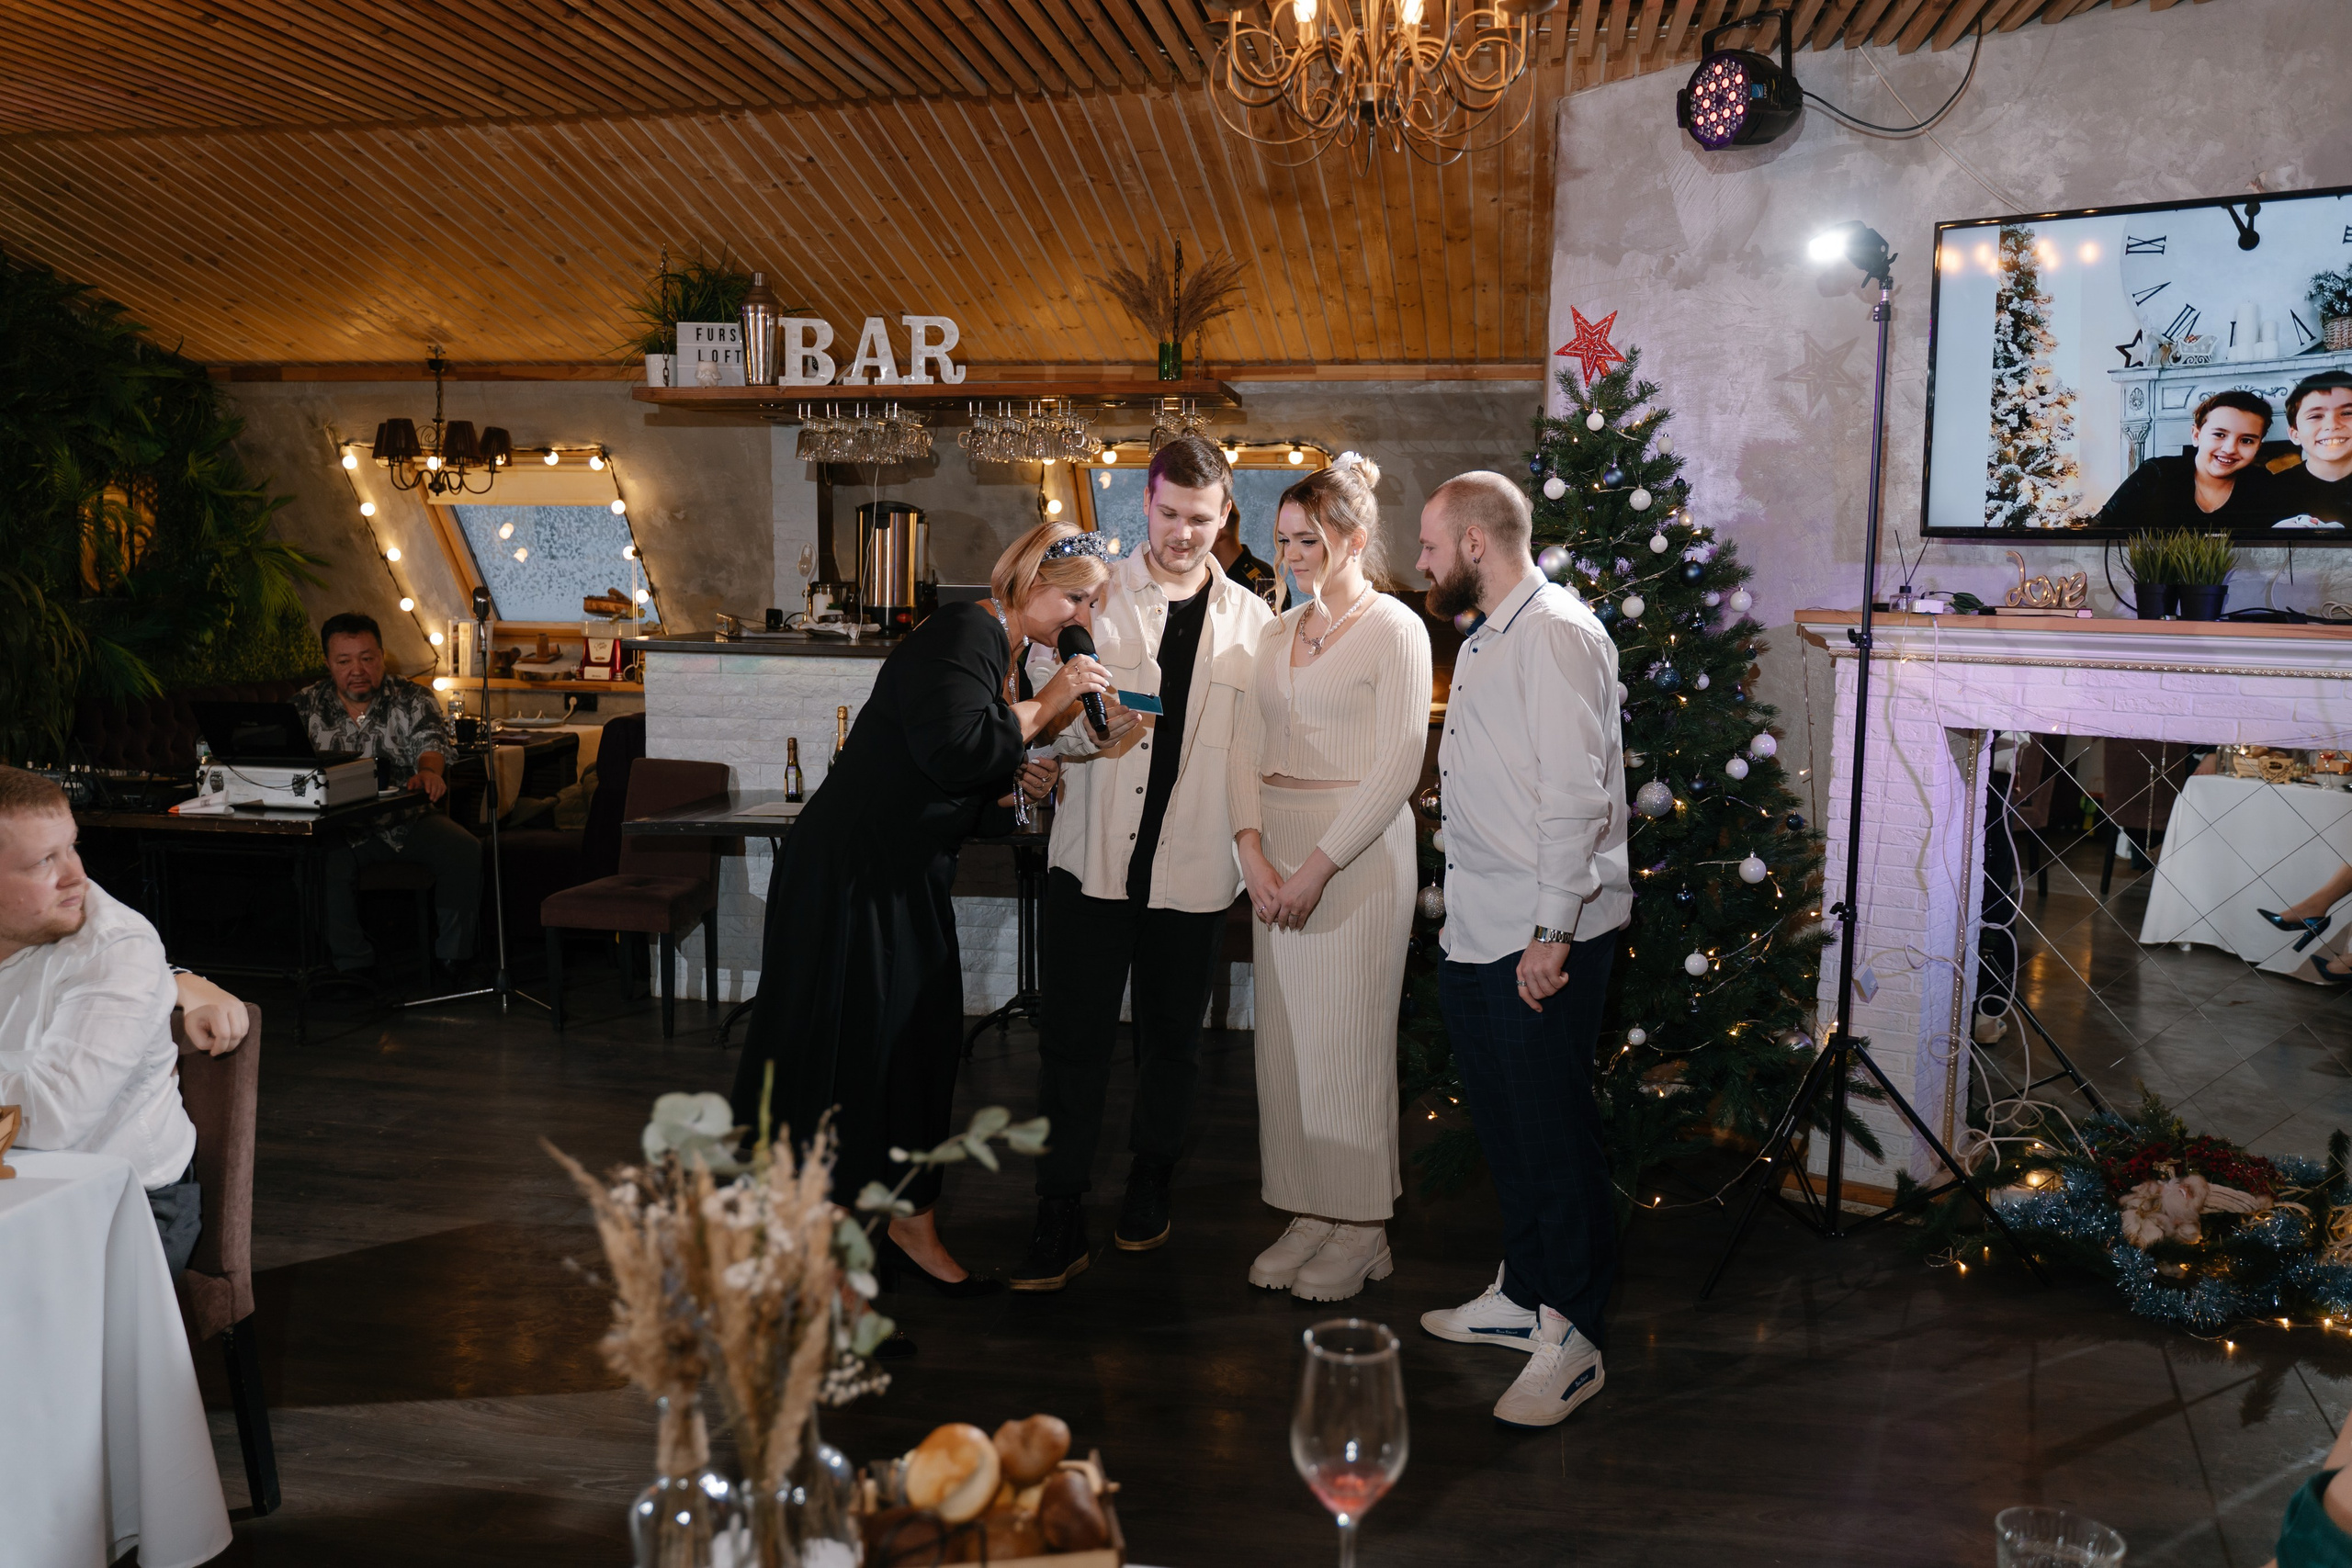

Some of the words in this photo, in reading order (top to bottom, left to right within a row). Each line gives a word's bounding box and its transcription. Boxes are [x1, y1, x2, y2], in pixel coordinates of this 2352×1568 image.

[695, 327, 737, 342] FURS
[697, 349, 741, 364] LOFT
[778, 316, 967, 386] BAR
